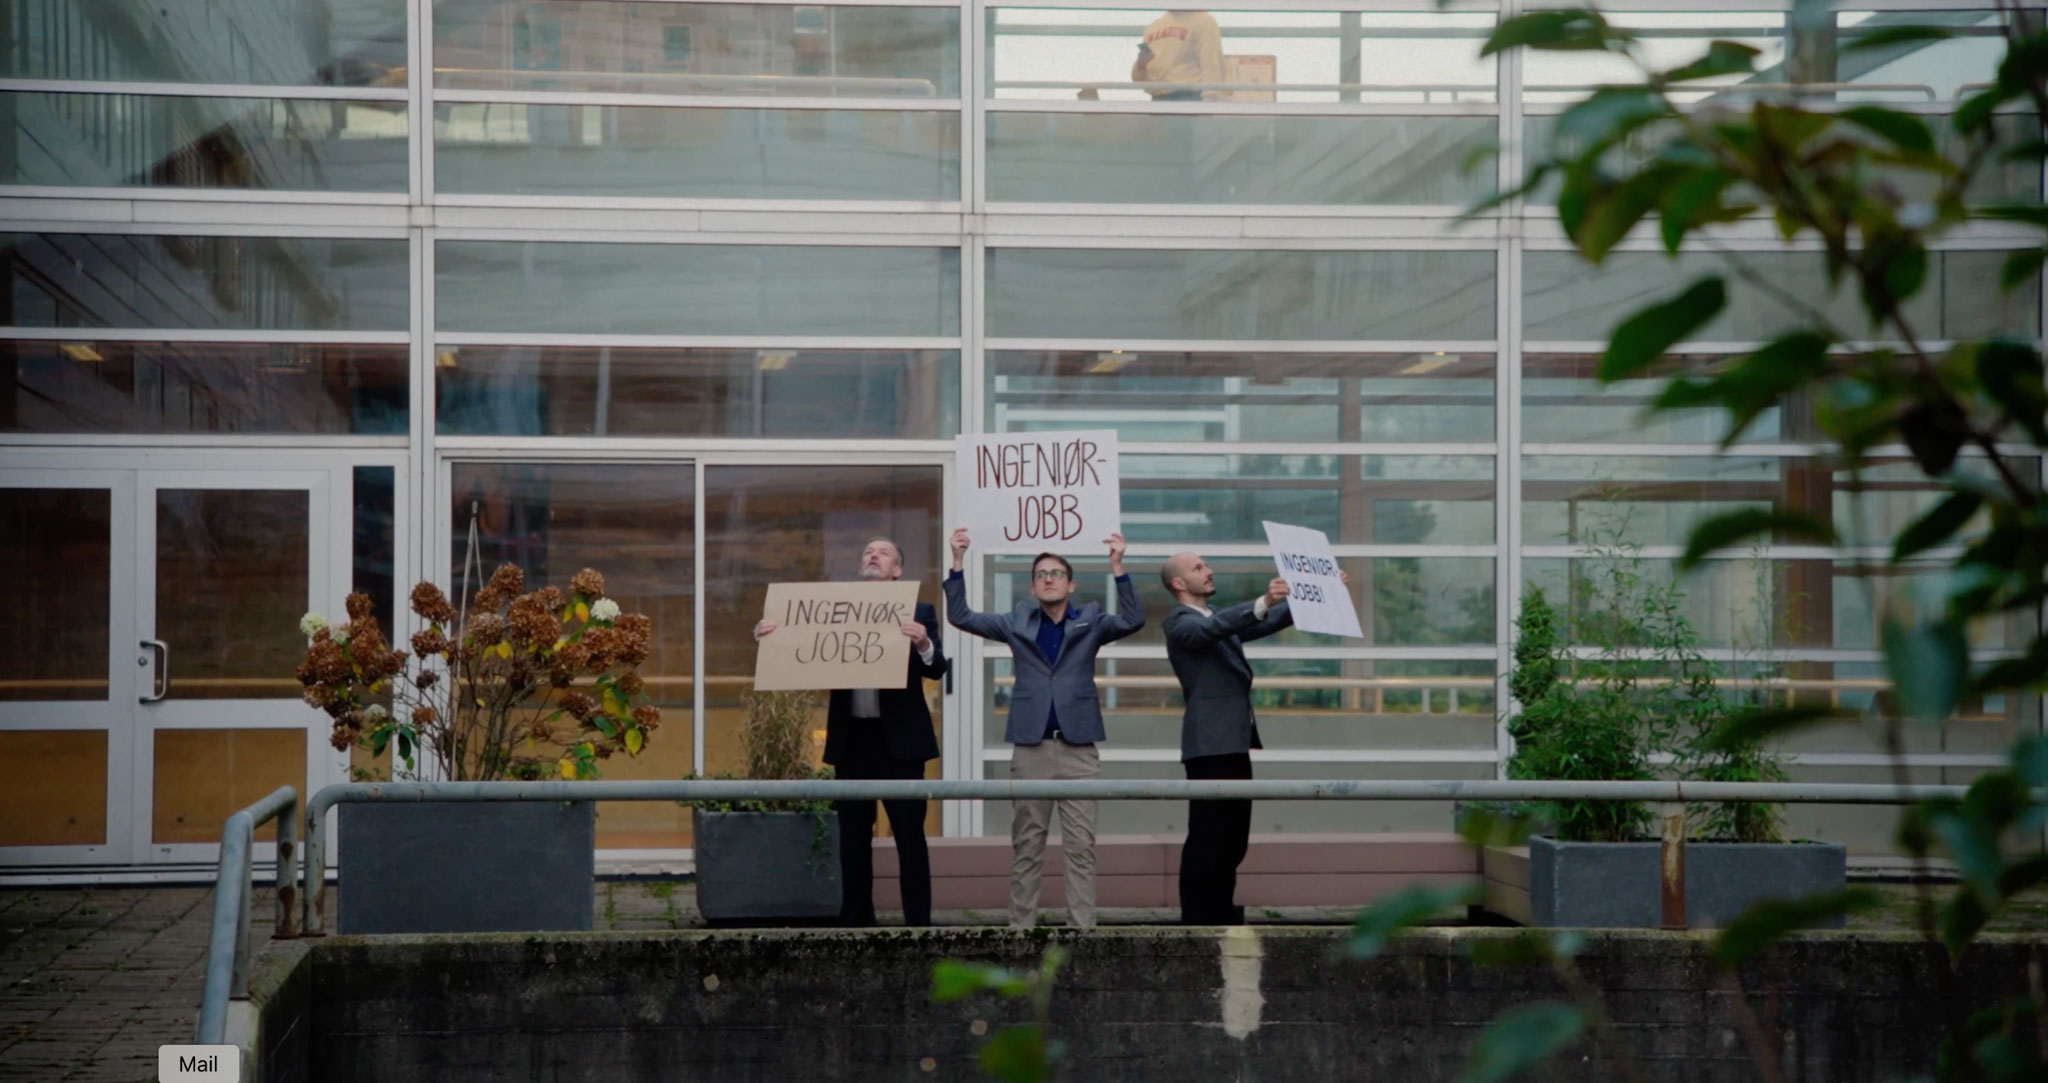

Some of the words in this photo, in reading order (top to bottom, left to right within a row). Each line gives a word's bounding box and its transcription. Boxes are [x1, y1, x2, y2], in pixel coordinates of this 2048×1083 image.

[977, 438, 1107, 489] INGENIØR-
[1003, 494, 1083, 542] JOBB
[1292, 581, 1326, 604] JOBB!
[785, 599, 911, 627] INGENIØR-
[795, 631, 885, 664] JOBB
